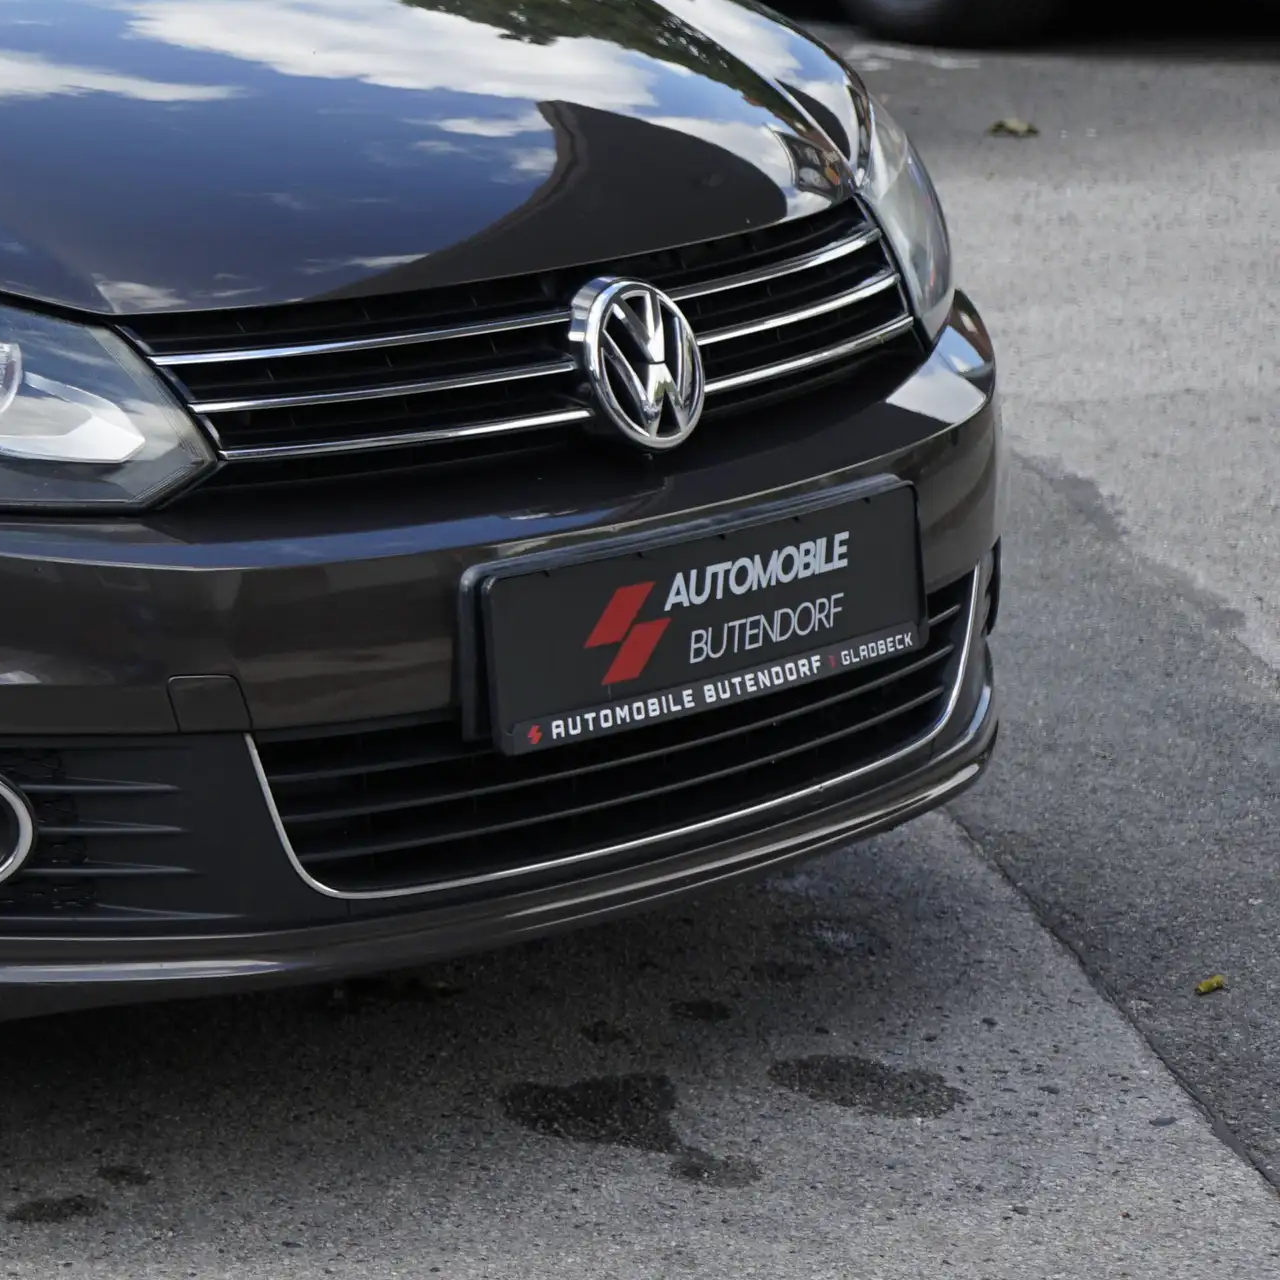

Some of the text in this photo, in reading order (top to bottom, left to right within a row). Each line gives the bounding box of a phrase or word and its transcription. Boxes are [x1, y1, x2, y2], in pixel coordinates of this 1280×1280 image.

[664, 531, 850, 612] AUTOMOBILE
[690, 592, 845, 664] BUTENDORF
[551, 631, 914, 740] AUTOMOBILE BUTENDORF GLADBECK
